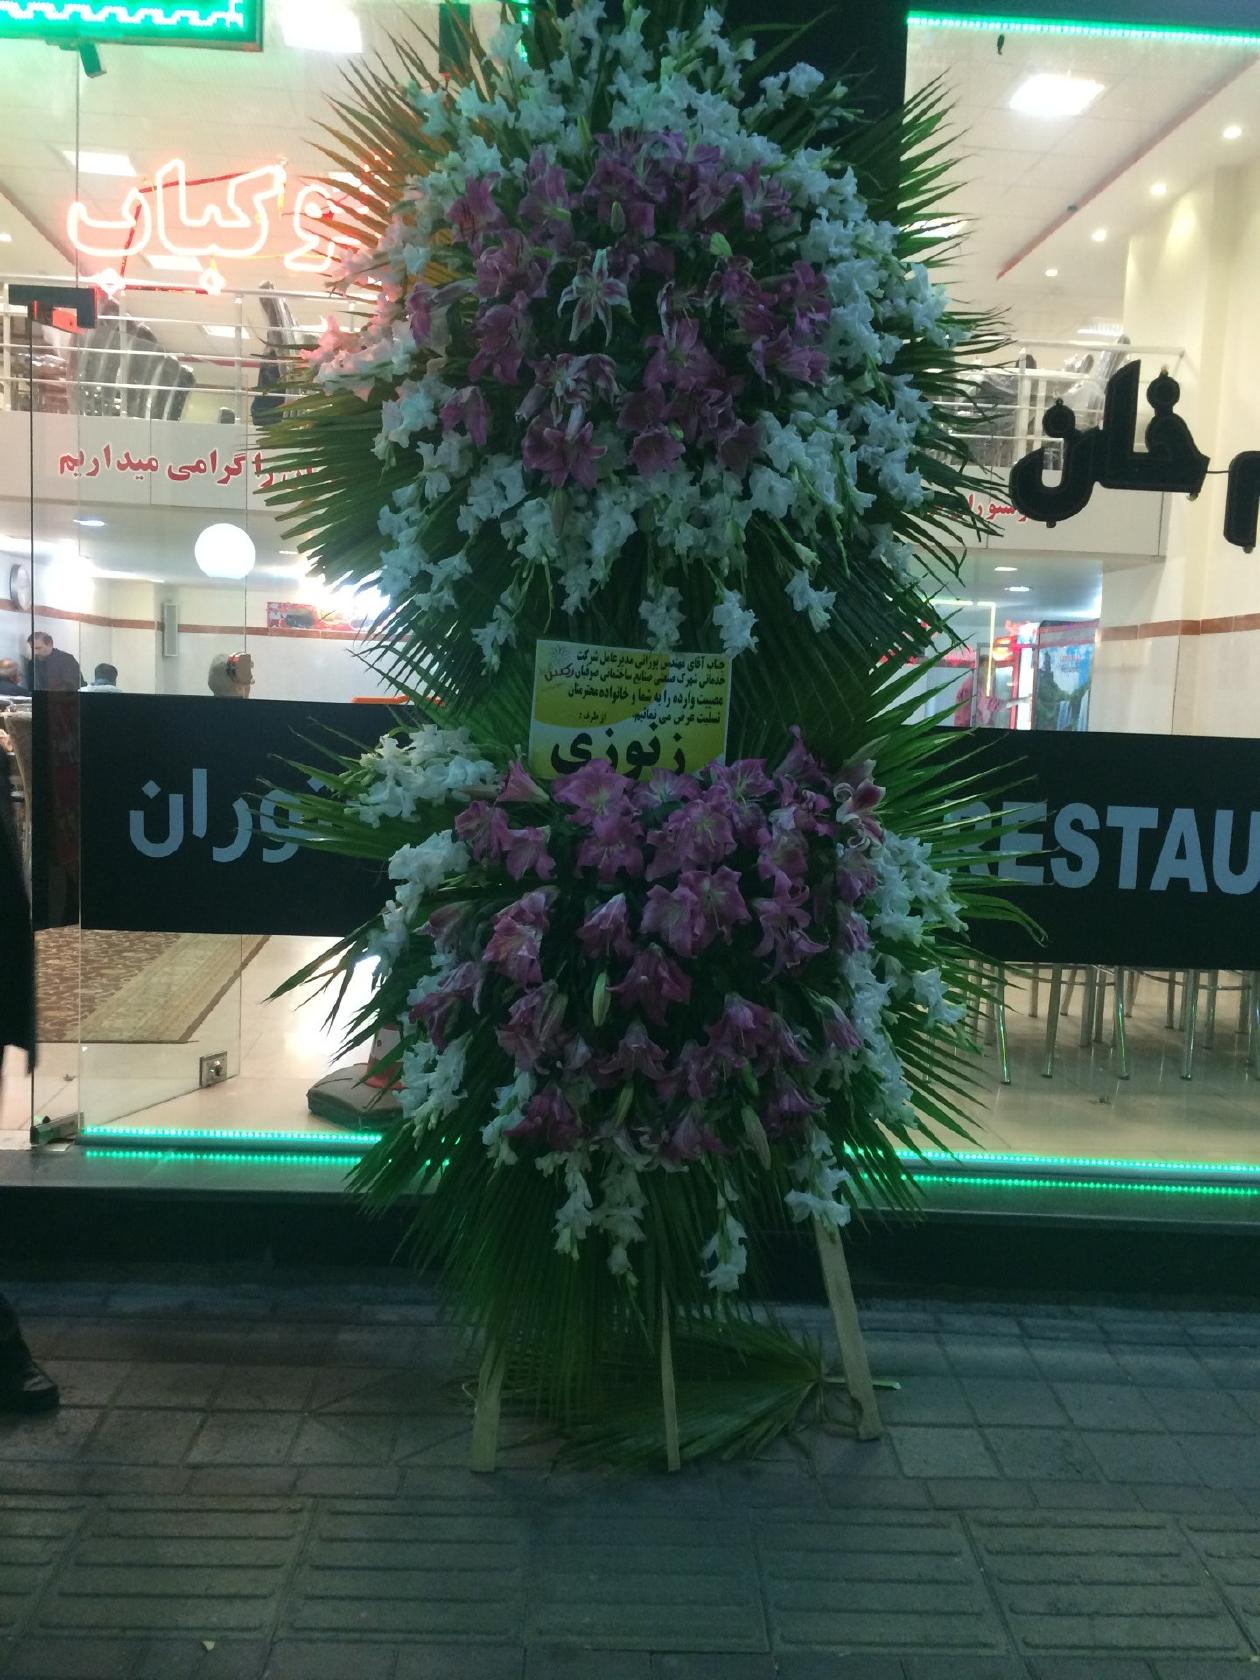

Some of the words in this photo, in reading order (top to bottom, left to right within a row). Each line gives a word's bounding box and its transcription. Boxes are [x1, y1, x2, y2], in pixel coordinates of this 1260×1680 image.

[66, 158, 287, 299] کباب
[59, 443, 160, 481] میداریم
[167, 449, 246, 485] گرامی
[576, 649, 598, 664] شرکت
[687, 656, 705, 672] آقای
[599, 685, 629, 704] خانواده
[696, 711, 721, 726] تسلیت
